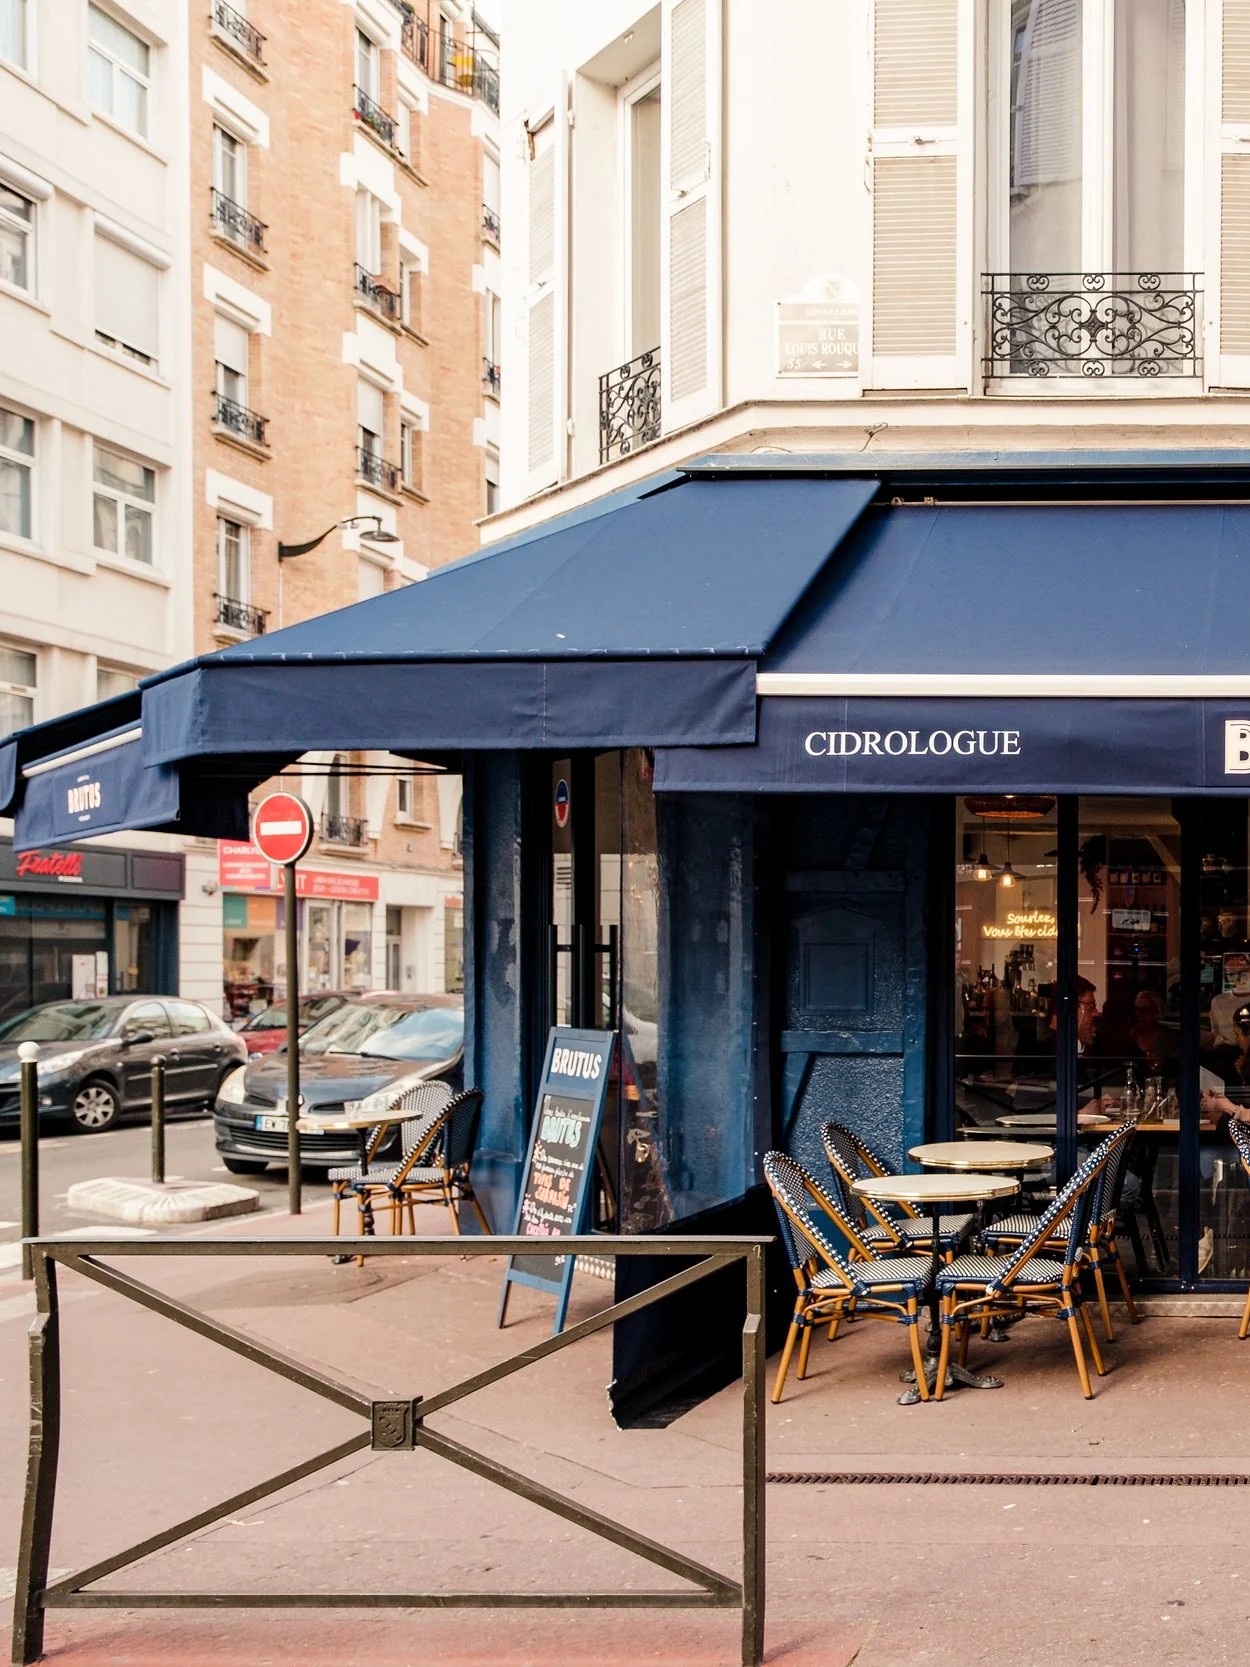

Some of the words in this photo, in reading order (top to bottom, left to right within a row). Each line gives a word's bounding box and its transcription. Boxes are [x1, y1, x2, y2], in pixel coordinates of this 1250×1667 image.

[818, 328, 846, 340] RUE
[785, 343, 818, 355] LOUIS
[804, 730, 1021, 756] CIDROLOGUE
[67, 782, 101, 814] BRUTUS
[983, 925, 1013, 937] Vous
[551, 1047, 602, 1080] BRUTUS
